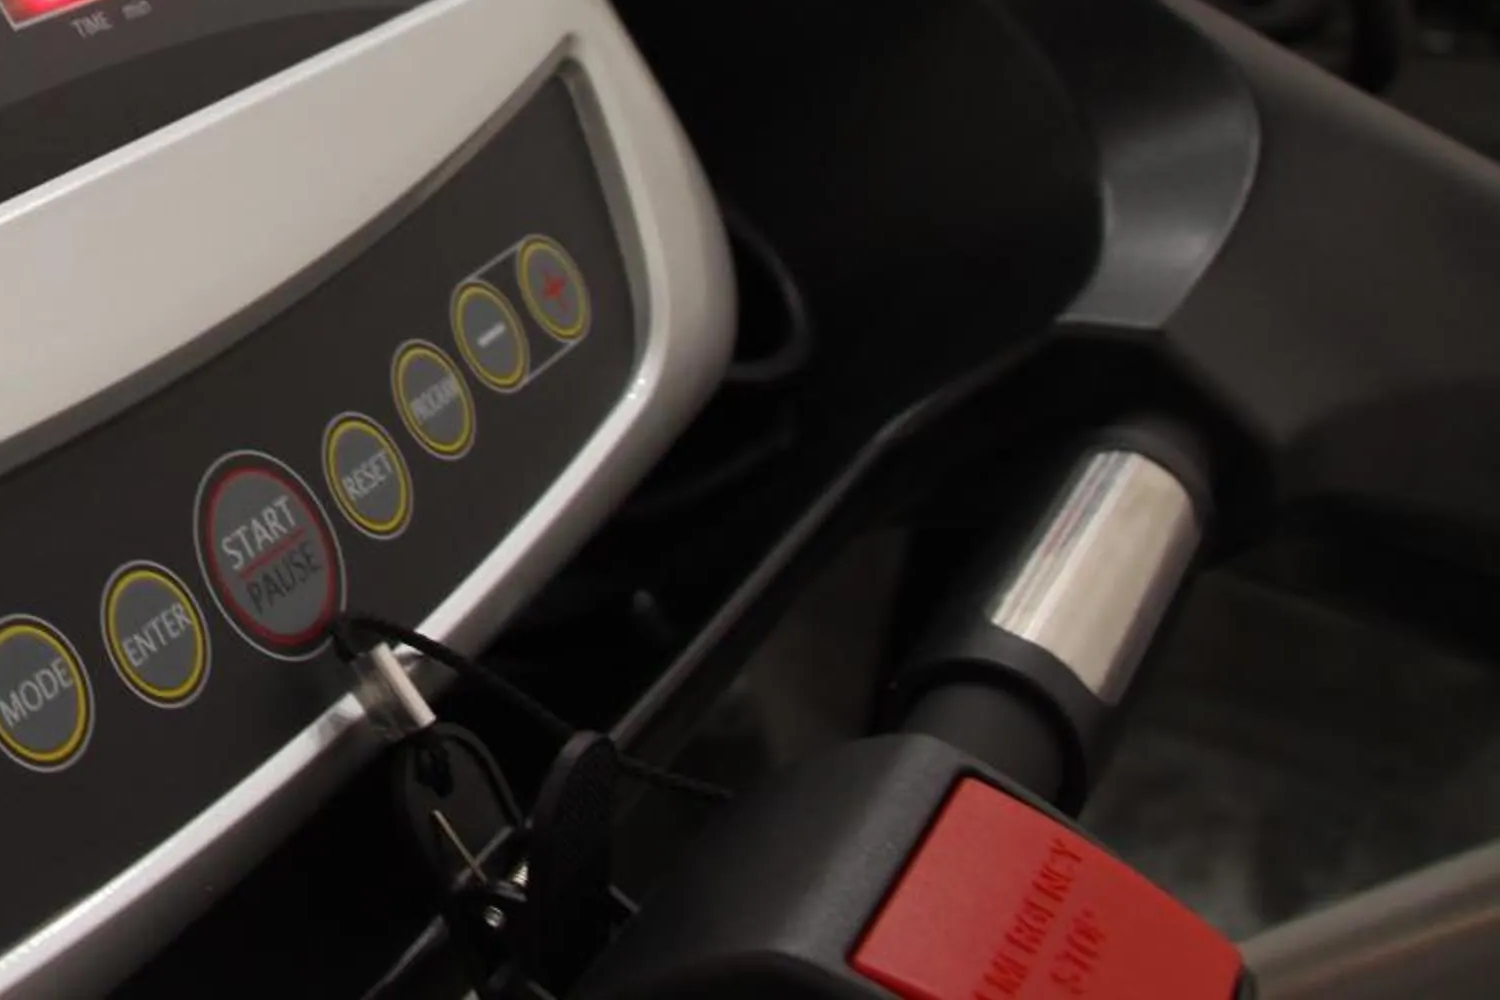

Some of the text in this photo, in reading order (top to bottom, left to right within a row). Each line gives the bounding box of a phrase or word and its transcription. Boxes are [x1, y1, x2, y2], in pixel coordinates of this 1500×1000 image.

[70, 10, 114, 38] TIME
[342, 450, 393, 502] RESET
[221, 494, 296, 572] START
[246, 541, 322, 614] PAUSE
[121, 601, 194, 668] ENTER
